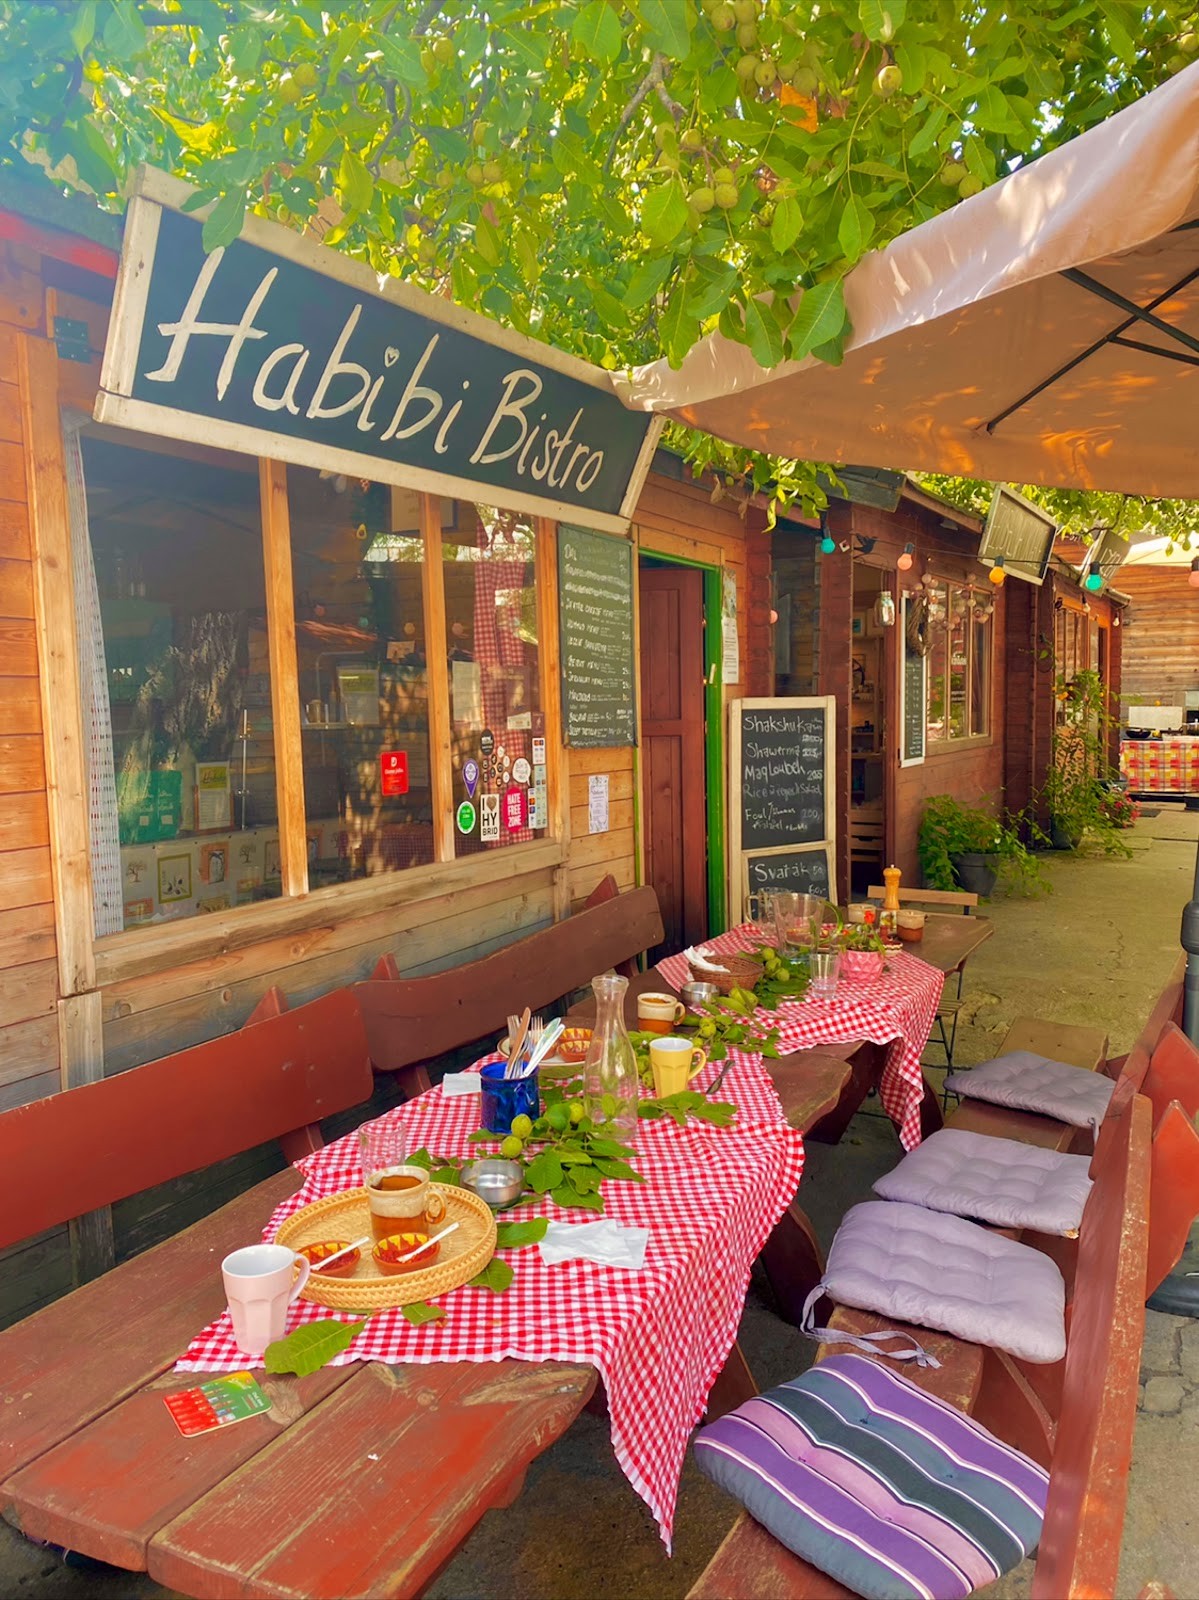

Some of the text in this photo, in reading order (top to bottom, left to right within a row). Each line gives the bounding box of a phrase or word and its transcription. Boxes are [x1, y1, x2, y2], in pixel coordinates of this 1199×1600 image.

[144, 246, 604, 493] Habibi Bistro
[745, 742, 800, 759] Shawerma
[507, 792, 522, 805] HATE
[507, 804, 522, 816] FREE
[482, 812, 497, 827] HY
[508, 815, 522, 828] ZONE
[482, 827, 498, 837] BRID
